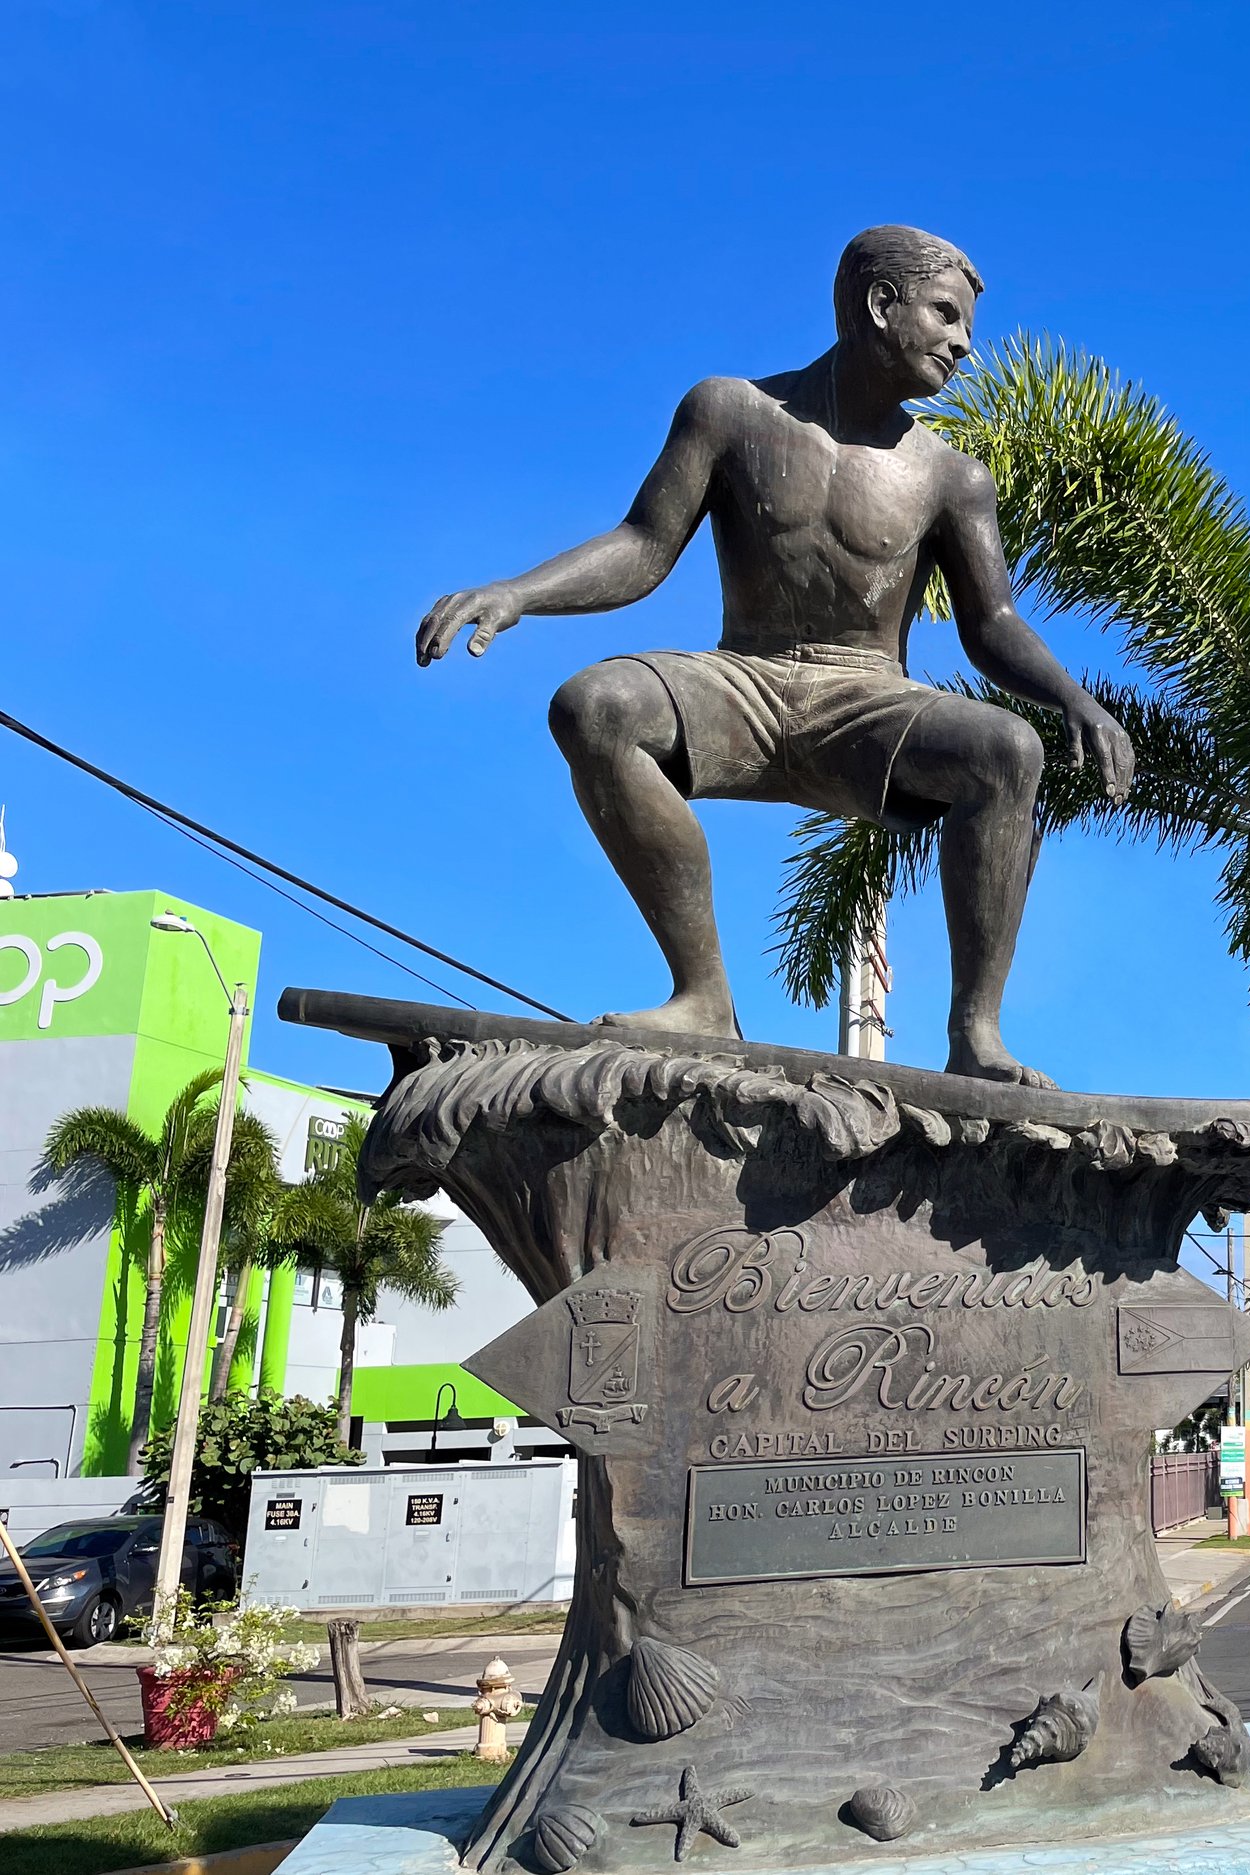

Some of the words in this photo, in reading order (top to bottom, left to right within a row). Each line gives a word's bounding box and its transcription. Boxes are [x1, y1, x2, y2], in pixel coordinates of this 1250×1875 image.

[667, 1225, 1103, 1313] Bienvenidos
[707, 1374, 759, 1413] a
[803, 1323, 1083, 1411] Rincón
[710, 1432, 843, 1459] CAPITAL
[866, 1431, 921, 1454] DEL
[943, 1424, 1062, 1449] SURFING
[765, 1472, 885, 1494] MUNICIPIO
[894, 1470, 923, 1487] DE
[932, 1466, 1016, 1485] RINCON
[709, 1503, 764, 1521] HON.
[776, 1497, 865, 1518] CARLOS
[877, 1492, 950, 1512] LOPEZ
[962, 1488, 1066, 1508] BONILLA
[828, 1516, 958, 1540] ALCALDE
